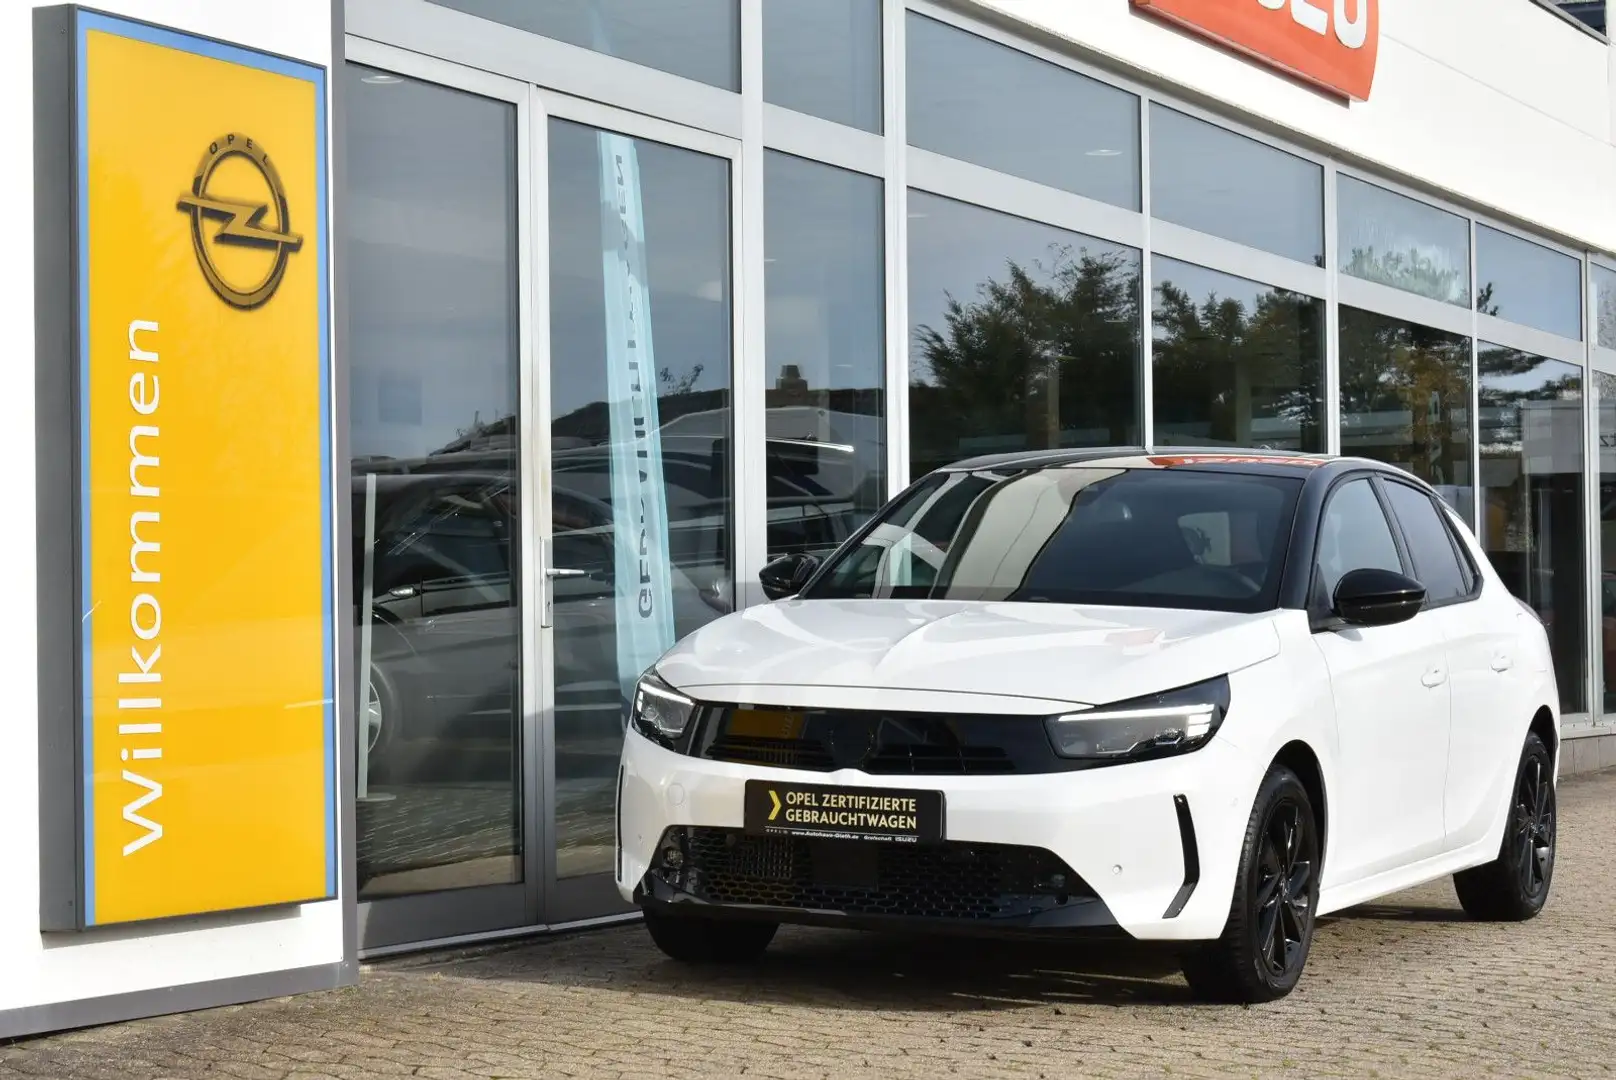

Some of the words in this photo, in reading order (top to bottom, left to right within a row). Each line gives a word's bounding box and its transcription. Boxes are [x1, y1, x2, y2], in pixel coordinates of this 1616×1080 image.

[209, 134, 268, 165] OPEL
[118, 319, 163, 857] Willkommen
[785, 791, 819, 807] OPEL
[821, 794, 917, 812] ZERTIFIZIERTE
[785, 808, 917, 829] GEBRAUCHTWAGEN
